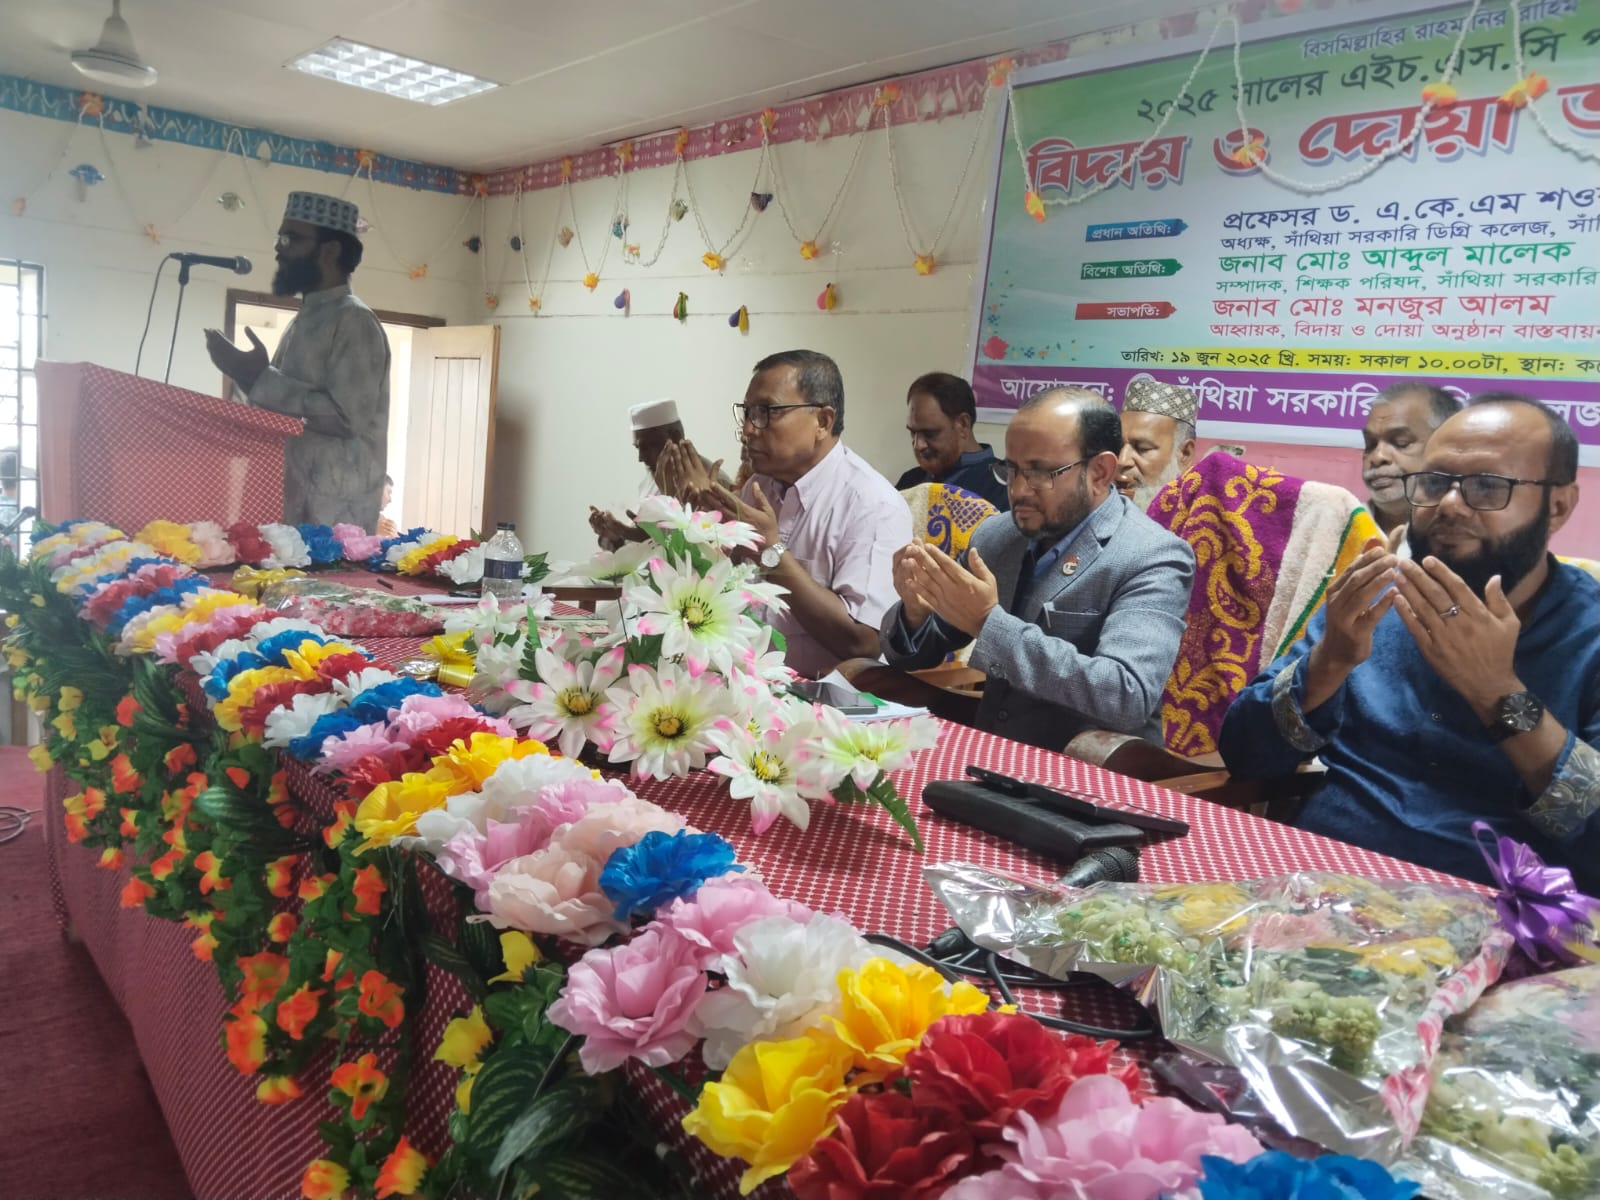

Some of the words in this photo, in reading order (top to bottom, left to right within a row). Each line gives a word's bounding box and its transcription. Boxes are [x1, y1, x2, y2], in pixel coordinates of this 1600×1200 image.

[1137, 89, 1219, 122] ২০২৫
[1231, 71, 1329, 105] সালের
[1027, 136, 1189, 194] বিদায়
[1213, 128, 1269, 171] ও
[1299, 94, 1516, 161] দোয়া
[1223, 207, 1320, 231] প্রফেসর
[1328, 205, 1359, 224] ড.
[1536, 187, 1600, 211] শও
[1092, 227, 1122, 240] প্রধান
[1221, 236, 1276, 251] অধ্যক্ষ,
[1285, 230, 1341, 247] সাঁথিয়া
[1348, 224, 1420, 244] সরকারি
[1427, 221, 1473, 240] ডিগ্রি
[1480, 221, 1556, 238] কলেজ,
[1083, 264, 1118, 278] বিশেষ
[1219, 252, 1287, 274] জনাব
[1297, 250, 1351, 271] মোঃ
[1361, 246, 1453, 273] আব্দুল
[1462, 242, 1576, 266] মালেক
[1216, 280, 1287, 294] সম্পাদক,
[1296, 274, 1352, 292] শিক্ষক
[1360, 272, 1427, 292] পরিষদ,
[1437, 269, 1506, 289] সাঁথিয়া
[1513, 266, 1600, 287] সরকারি
[1212, 297, 1280, 317] জনাব
[1290, 296, 1344, 317] মোঃ
[1354, 297, 1448, 321] মনজুর
[1458, 293, 1556, 316] আলম
[1294, 320, 1344, 337] বিদায়
[1351, 324, 1366, 337] ও
[1374, 324, 1425, 338] দোয়া
[1432, 319, 1507, 341] অনুষ্ঠান
[1513, 324, 1600, 339] বাস্তবায়
[1171, 352, 1190, 364] ১৯
[1196, 352, 1221, 367] জুন
[1226, 353, 1271, 366] ২০২৫
[1359, 354, 1412, 369] সকাল
[1265, 382, 1380, 418] সরকারি
